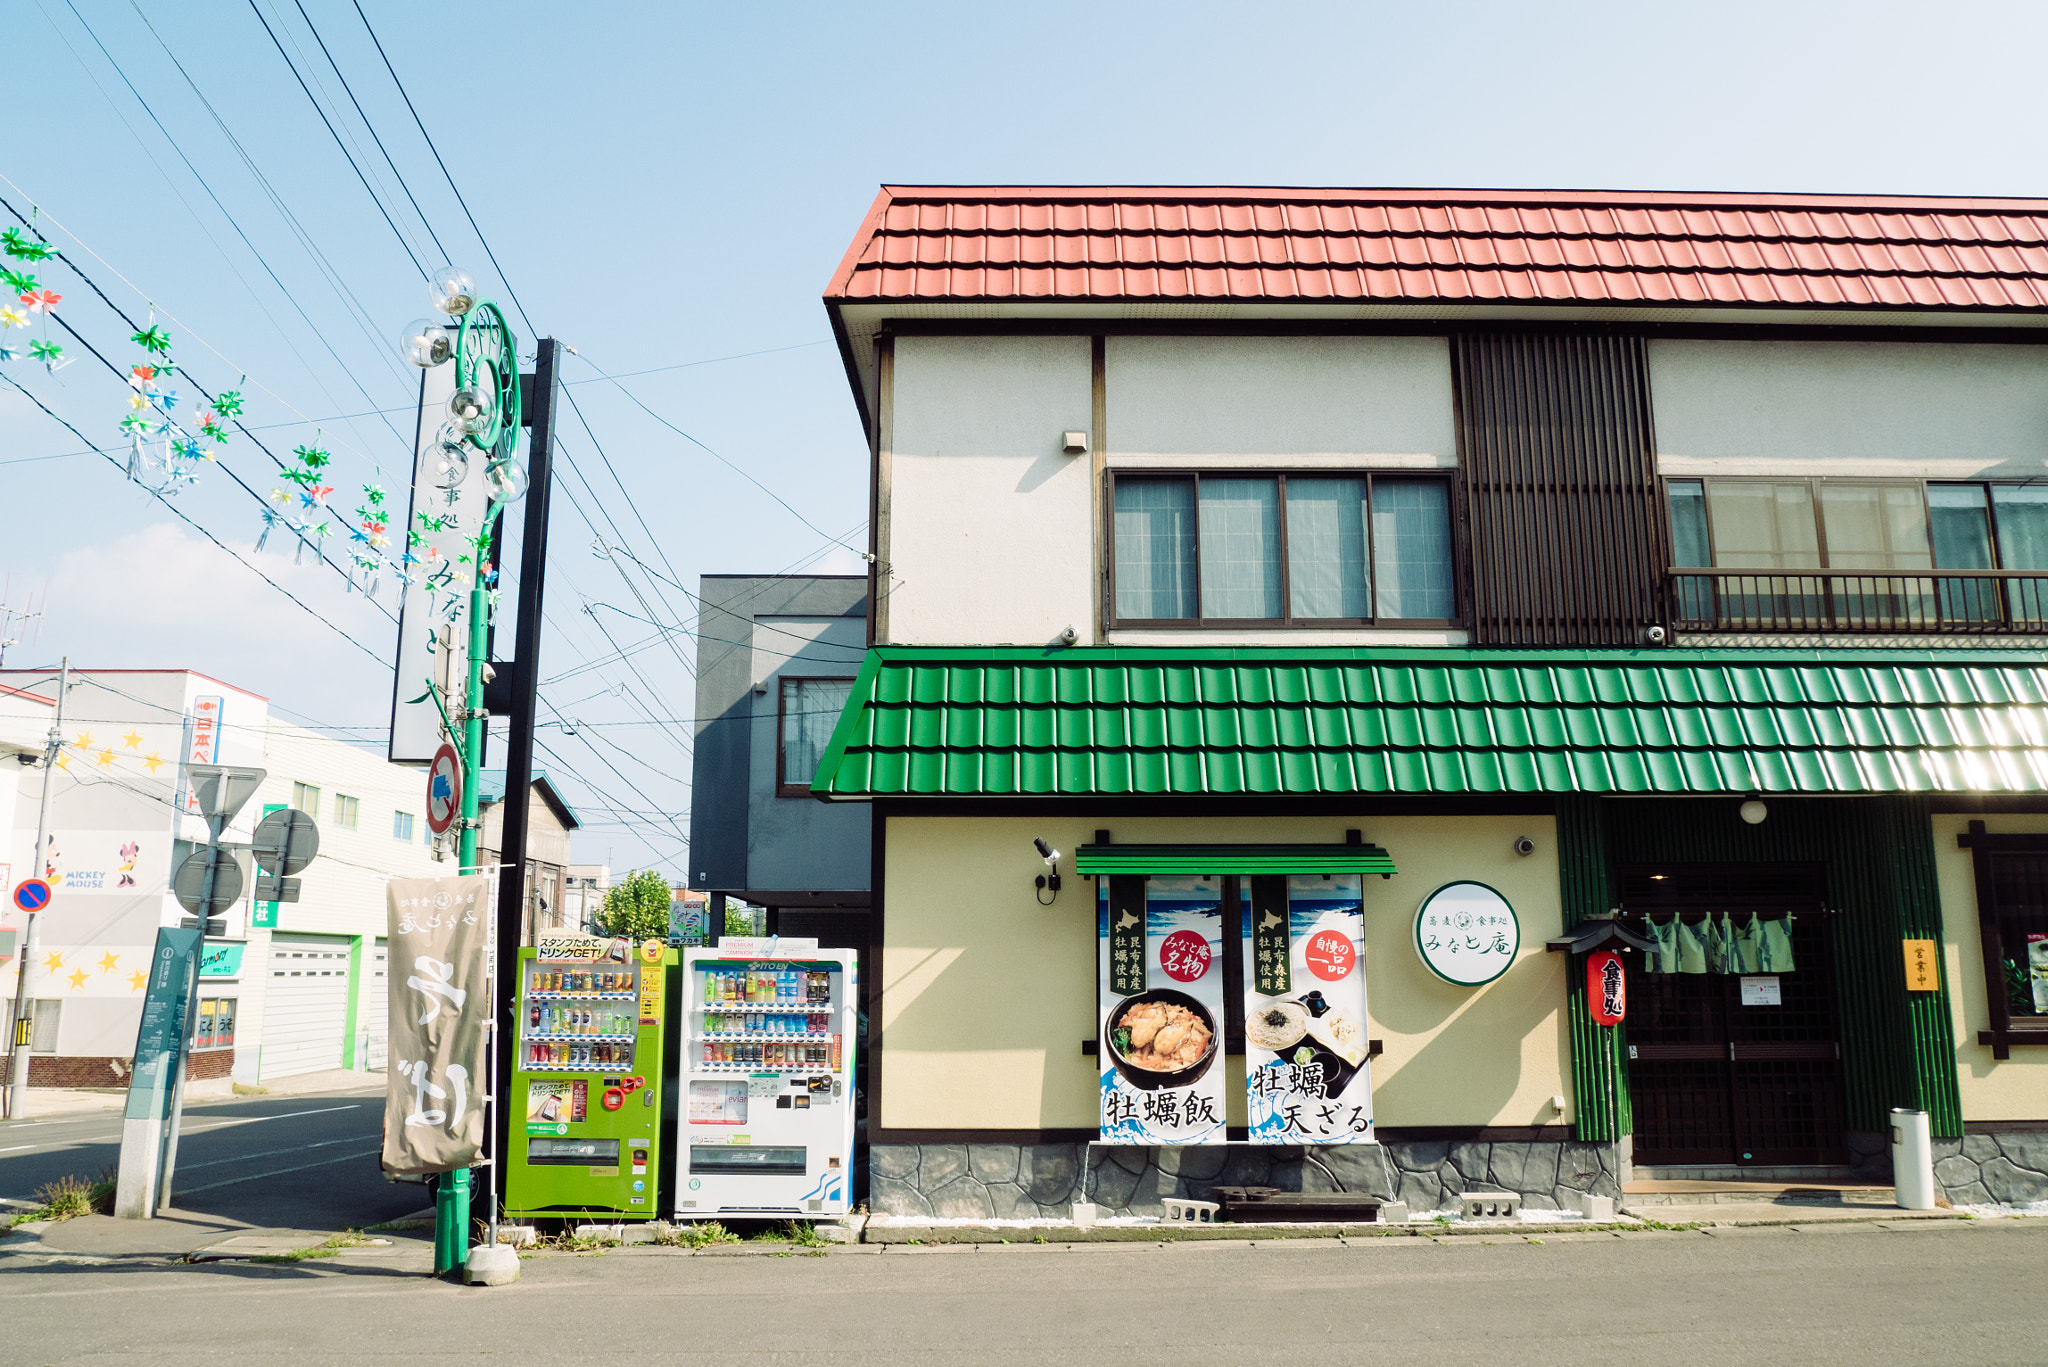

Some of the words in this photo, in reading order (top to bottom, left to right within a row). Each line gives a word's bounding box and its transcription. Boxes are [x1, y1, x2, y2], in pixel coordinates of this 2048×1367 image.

[65, 871, 106, 879] MICKEY
[65, 880, 104, 888] MOUSE
[1476, 915, 1508, 927] 食事処
[1165, 936, 1210, 960] みなと庵
[1316, 936, 1349, 955] 自慢の
[1425, 931, 1511, 955] みなと庵
[759, 963, 776, 971] ITO
[776, 963, 788, 971] EN
[1130, 936, 1143, 990] 昆布森産
[1163, 951, 1204, 978] 名物
[1273, 936, 1287, 990] 昆布森産
[1308, 955, 1347, 975] 一品
[1914, 947, 1927, 986] 営業中
[1602, 960, 1622, 1016] 食事処
[1253, 1065, 1326, 1100] 牡蠣
[728, 1095, 748, 1103] evian
[1106, 1090, 1220, 1129] 牡蠣飯
[1280, 1103, 1368, 1134] 天ざる
